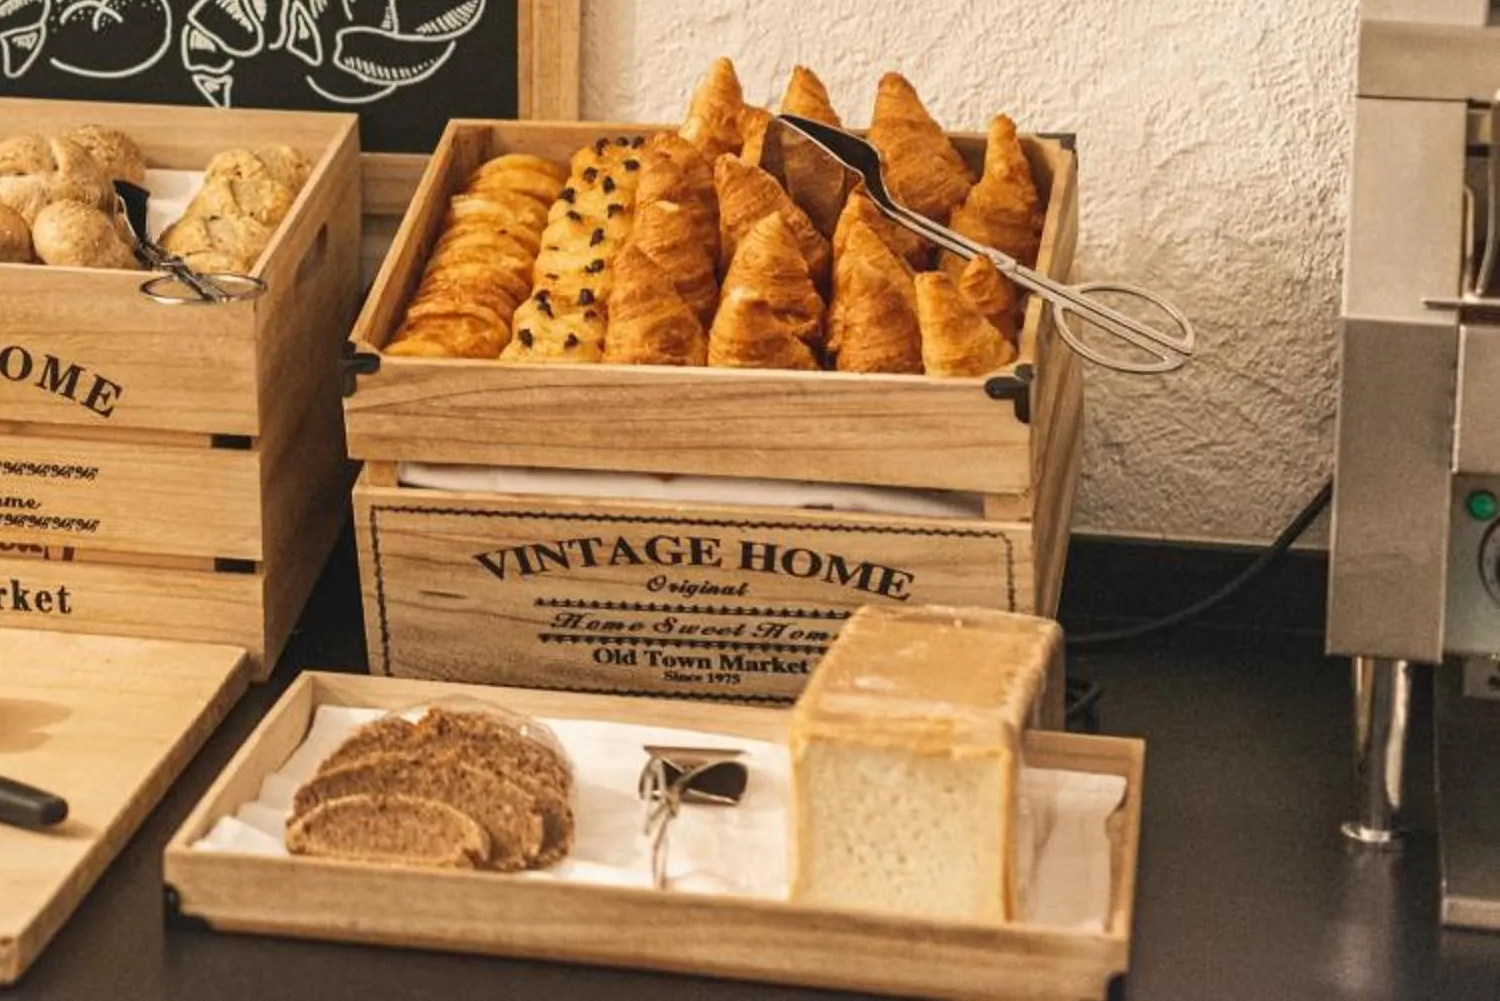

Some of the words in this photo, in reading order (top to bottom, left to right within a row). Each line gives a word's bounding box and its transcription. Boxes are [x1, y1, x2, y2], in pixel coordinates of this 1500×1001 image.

[473, 534, 723, 582] VINTAGE
[739, 539, 916, 601] HOME
[646, 575, 750, 598] Original
[550, 612, 646, 633] Home
[653, 616, 746, 638] Sweet
[592, 647, 638, 667] Old
[644, 649, 711, 670] Town
[718, 654, 812, 675] Market
[663, 670, 702, 683] Since
[707, 673, 741, 686] 1975
